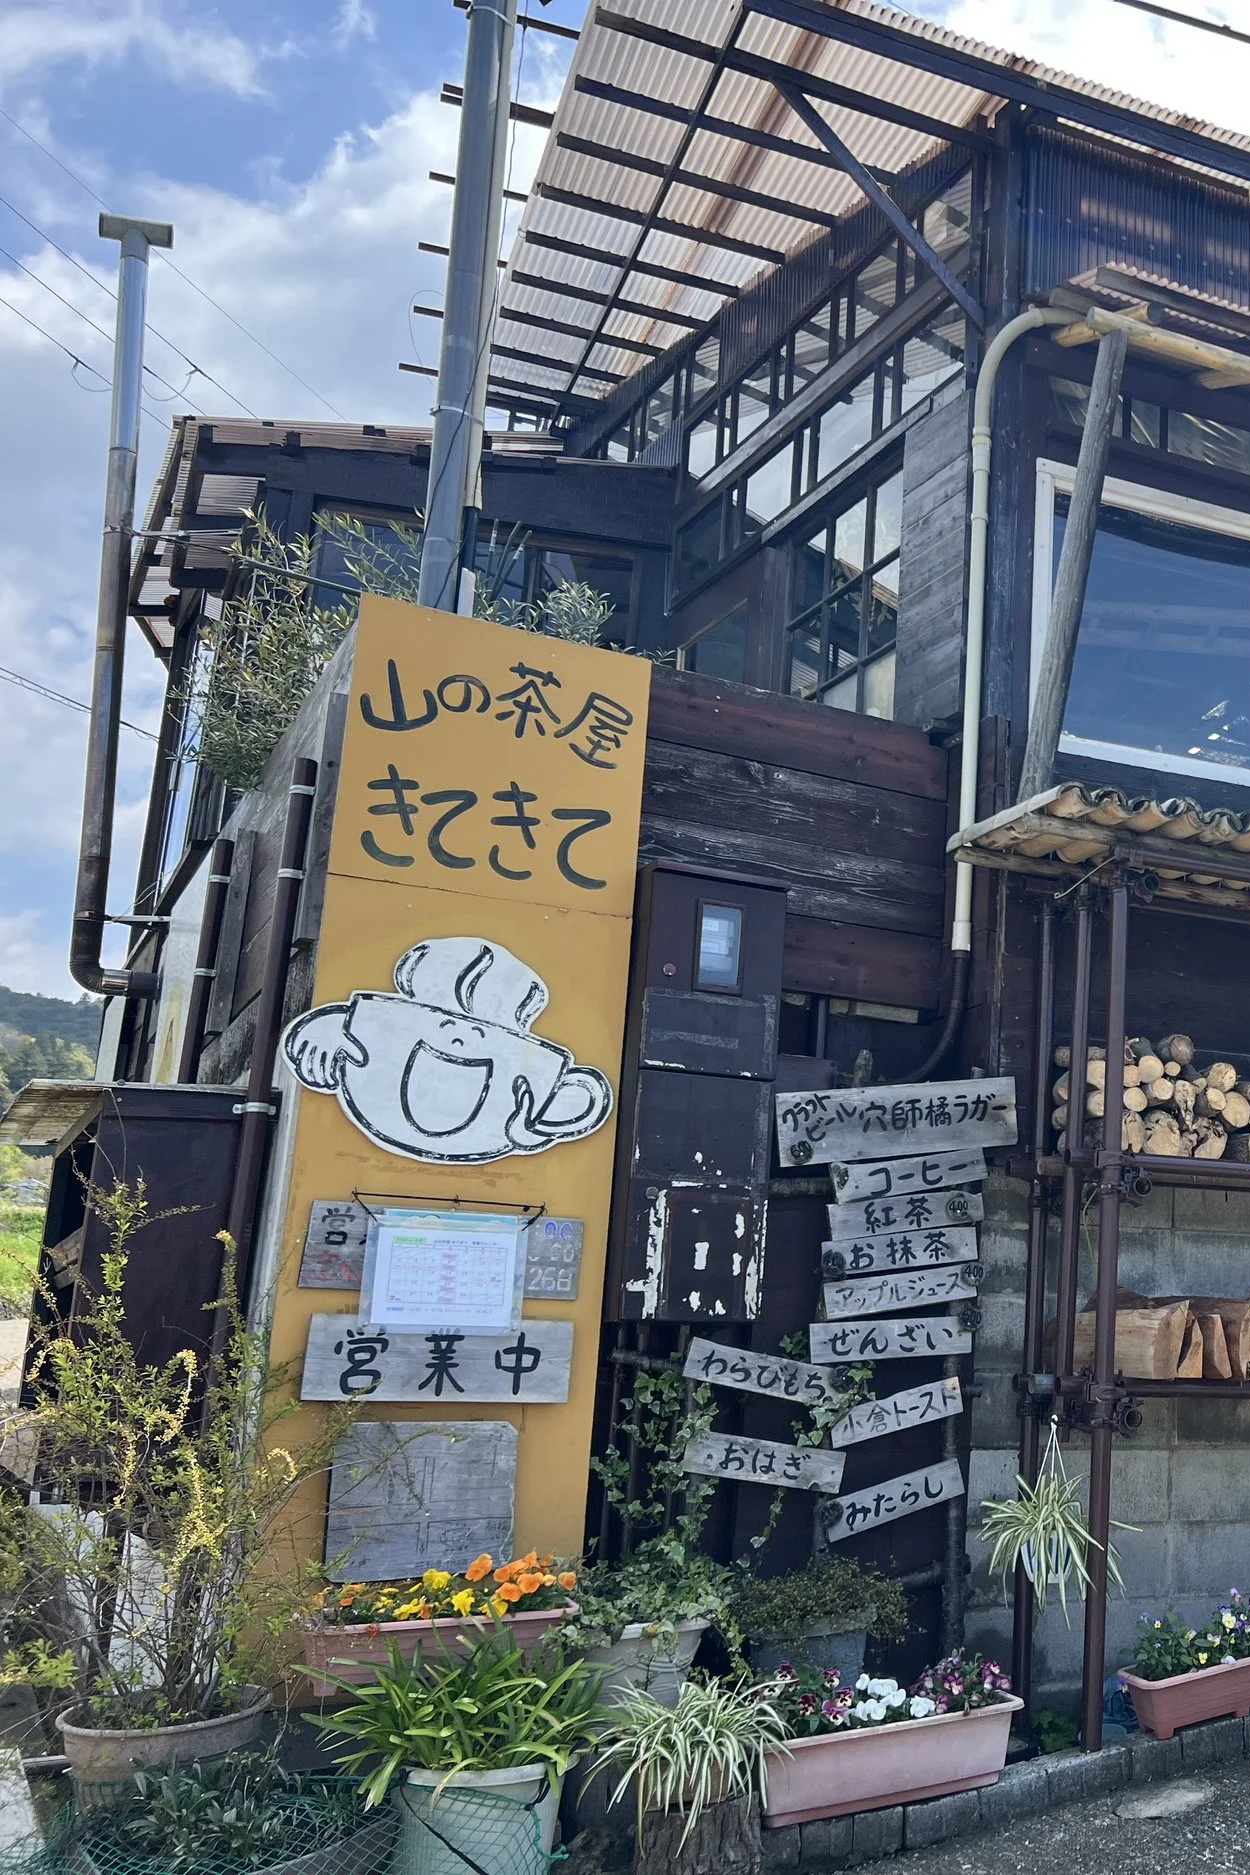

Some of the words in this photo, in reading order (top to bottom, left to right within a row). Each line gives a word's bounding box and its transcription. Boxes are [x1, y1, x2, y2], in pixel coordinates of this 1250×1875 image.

[359, 658, 634, 770] 山の茶屋
[360, 763, 613, 891] きてきて
[781, 1093, 831, 1133] クラフト
[805, 1102, 858, 1143] ビール
[858, 1093, 1008, 1133] 穴師橘ラガー
[868, 1159, 969, 1197] コーヒー
[863, 1195, 933, 1235] 紅茶
[849, 1230, 951, 1268] お抹茶
[835, 1272, 967, 1304] アップルジュース
[828, 1323, 954, 1356] ぜんざい
[333, 1326, 542, 1397] 営業中
[701, 1349, 826, 1400] わらびもち
[842, 1387, 957, 1436] 小倉トースト
[718, 1441, 812, 1480] おはぎ
[844, 1475, 945, 1532] みたらし
